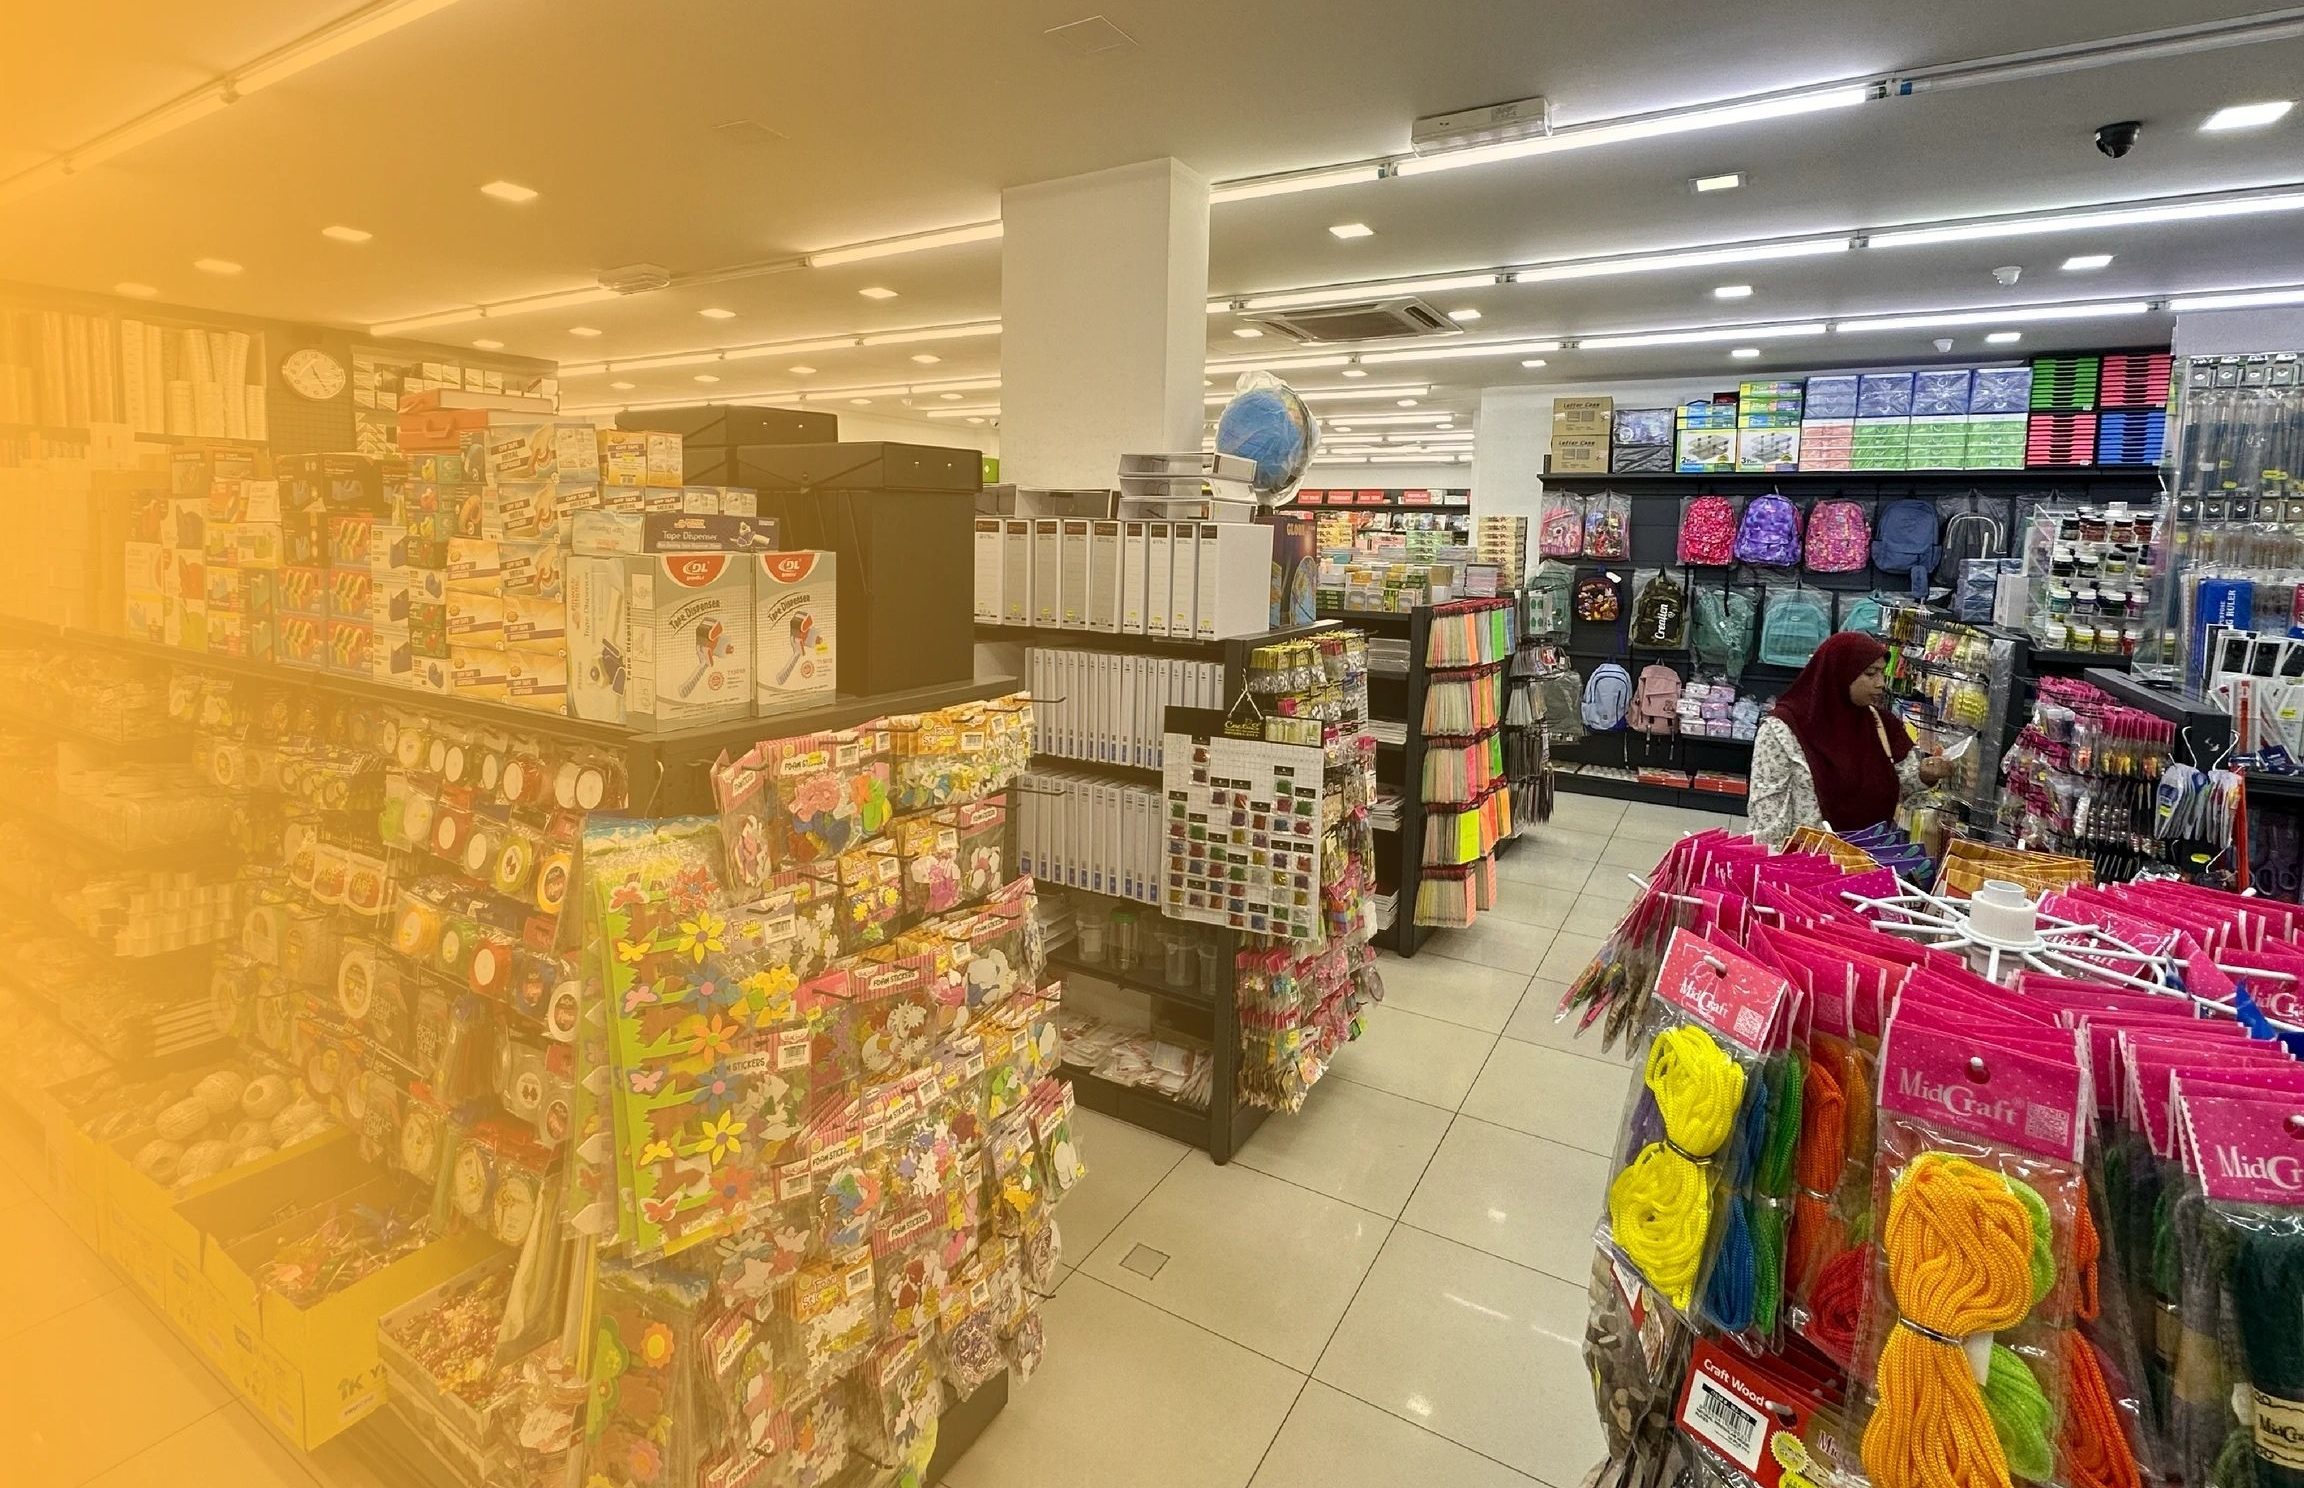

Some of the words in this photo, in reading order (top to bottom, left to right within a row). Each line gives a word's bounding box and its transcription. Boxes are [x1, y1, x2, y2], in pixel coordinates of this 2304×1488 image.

[662, 531, 681, 541] Tape
[683, 531, 718, 541] Dispenser
[2226, 590, 2236, 617] RULER
[1654, 603, 1668, 639] Creation
[784, 760, 801, 771] FOAM
[873, 977, 890, 987] FOAM
[890, 972, 915, 984] STICKERS
[1680, 976, 1729, 1018] MidCraft
[733, 1058, 766, 1072] STICKERS
[893, 1100, 914, 1117] STICKERS
[812, 1154, 829, 1167] FOAM
[891, 1225, 906, 1238] FOAM
[905, 1213, 928, 1229] STICKERS
[1703, 1358, 1730, 1384] Craft
[1730, 1375, 1764, 1408] Wood
